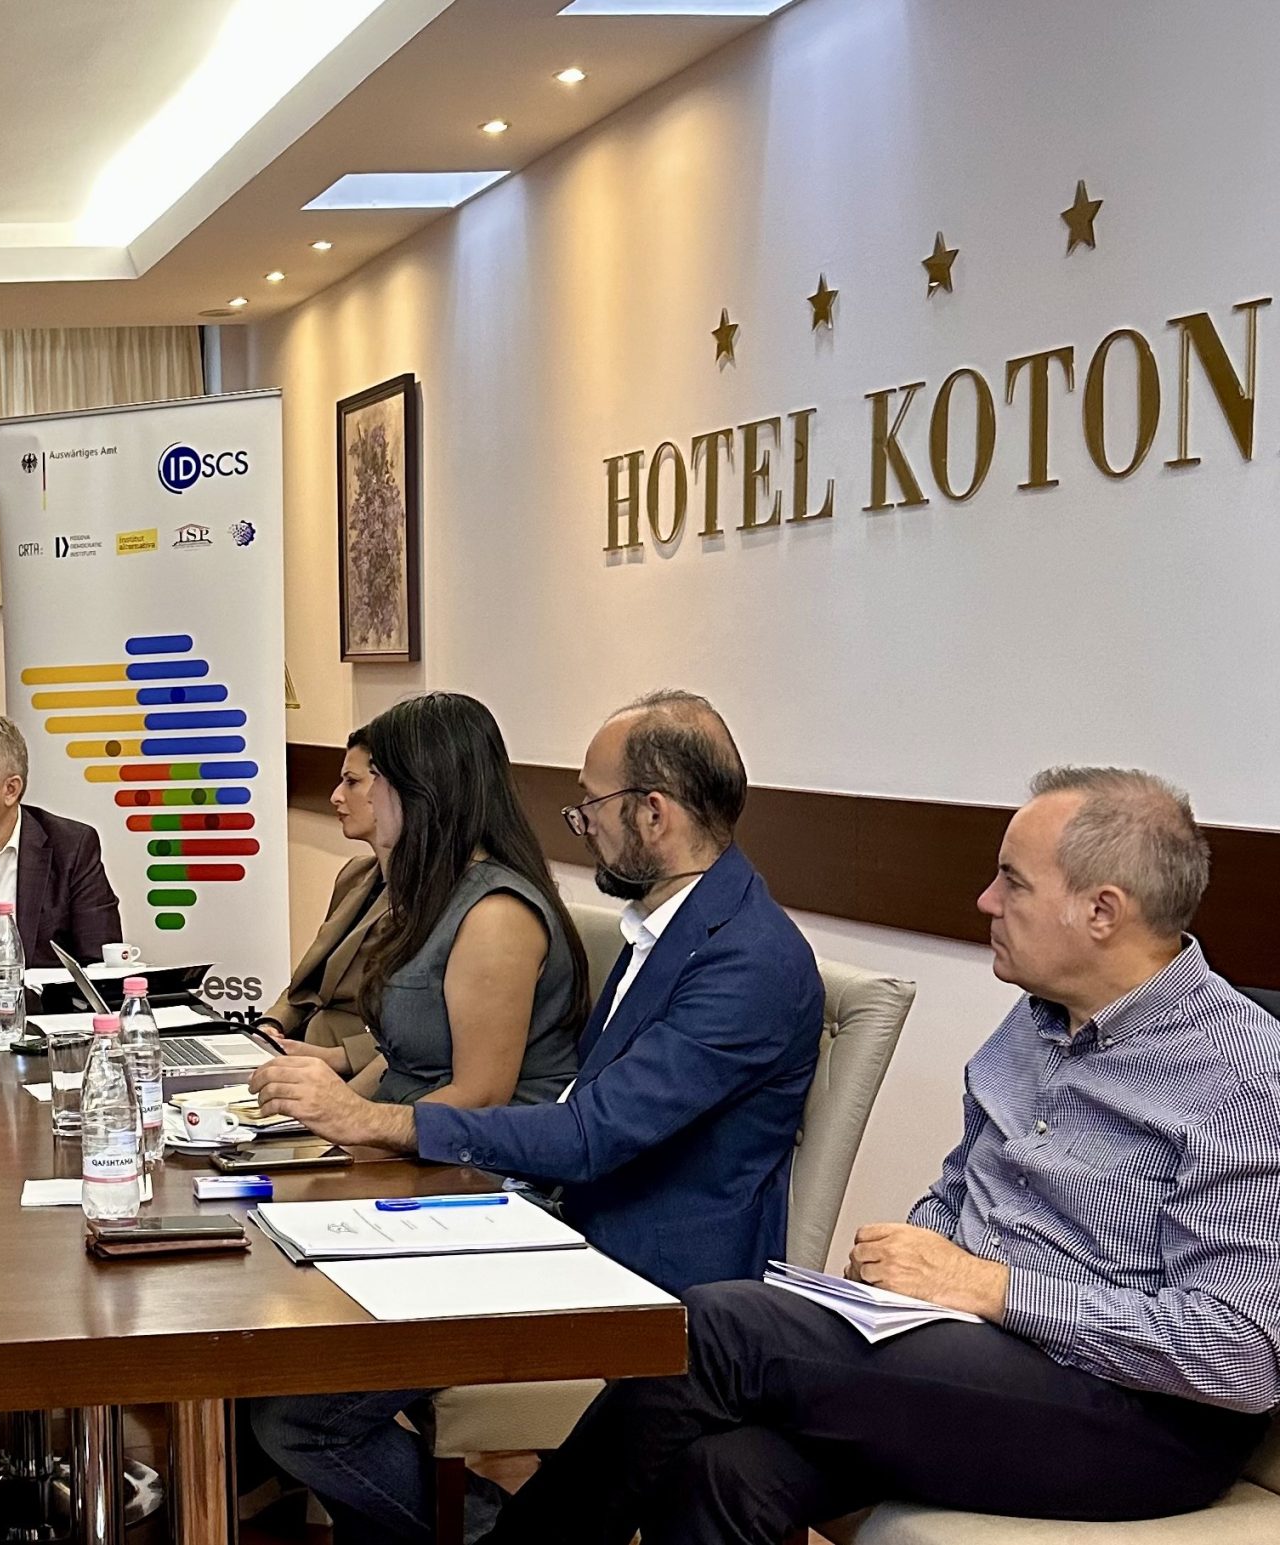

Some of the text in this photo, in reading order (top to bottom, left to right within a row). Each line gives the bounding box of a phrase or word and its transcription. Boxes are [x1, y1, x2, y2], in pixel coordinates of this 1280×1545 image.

[602, 297, 1273, 553] HOTEL KOTON
[49, 446, 118, 460] Auswärtiges Amt
[179, 528, 209, 542] ISP
[196, 976, 262, 1001] ess
